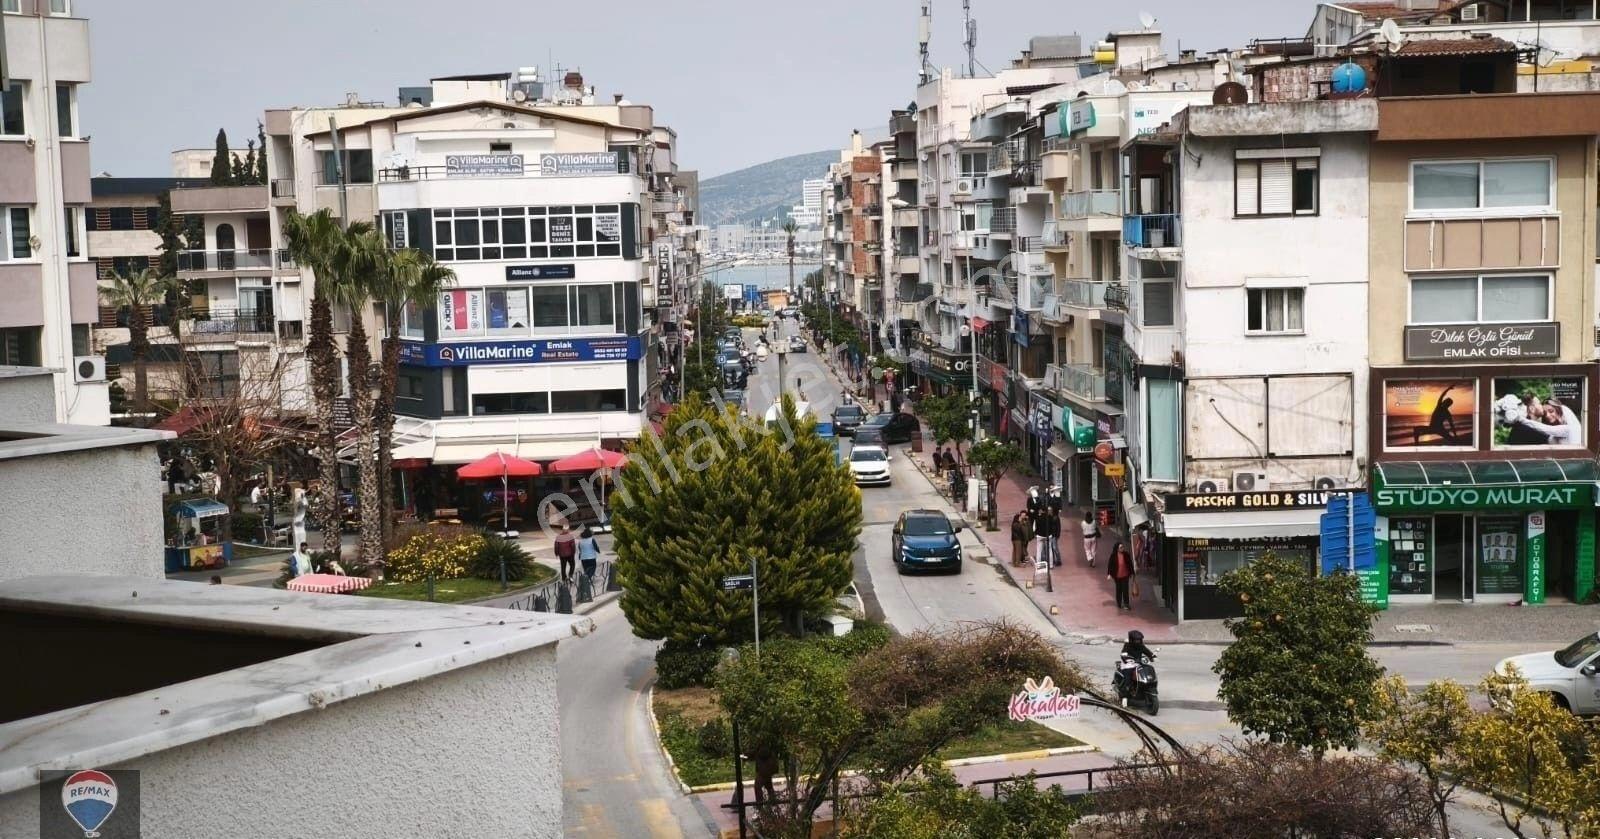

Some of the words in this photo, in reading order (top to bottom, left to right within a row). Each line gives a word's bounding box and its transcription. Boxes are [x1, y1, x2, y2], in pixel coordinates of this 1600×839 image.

[460, 155, 508, 164] VillaMarine
[558, 154, 614, 164] VillaMarine
[1430, 328, 1465, 343] Dilek
[1467, 327, 1497, 346] Özlü
[456, 344, 534, 360] VillaMarine
[547, 341, 573, 349] Emlak
[1444, 348, 1486, 357] EMLAK
[1490, 346, 1520, 356] OFİSİ
[1186, 495, 1235, 507] PASCHA
[1243, 494, 1279, 506] GOLD
[1283, 493, 1293, 505] &
[1377, 487, 1479, 505] STÜDYO
[1485, 488, 1576, 504] MURAT
